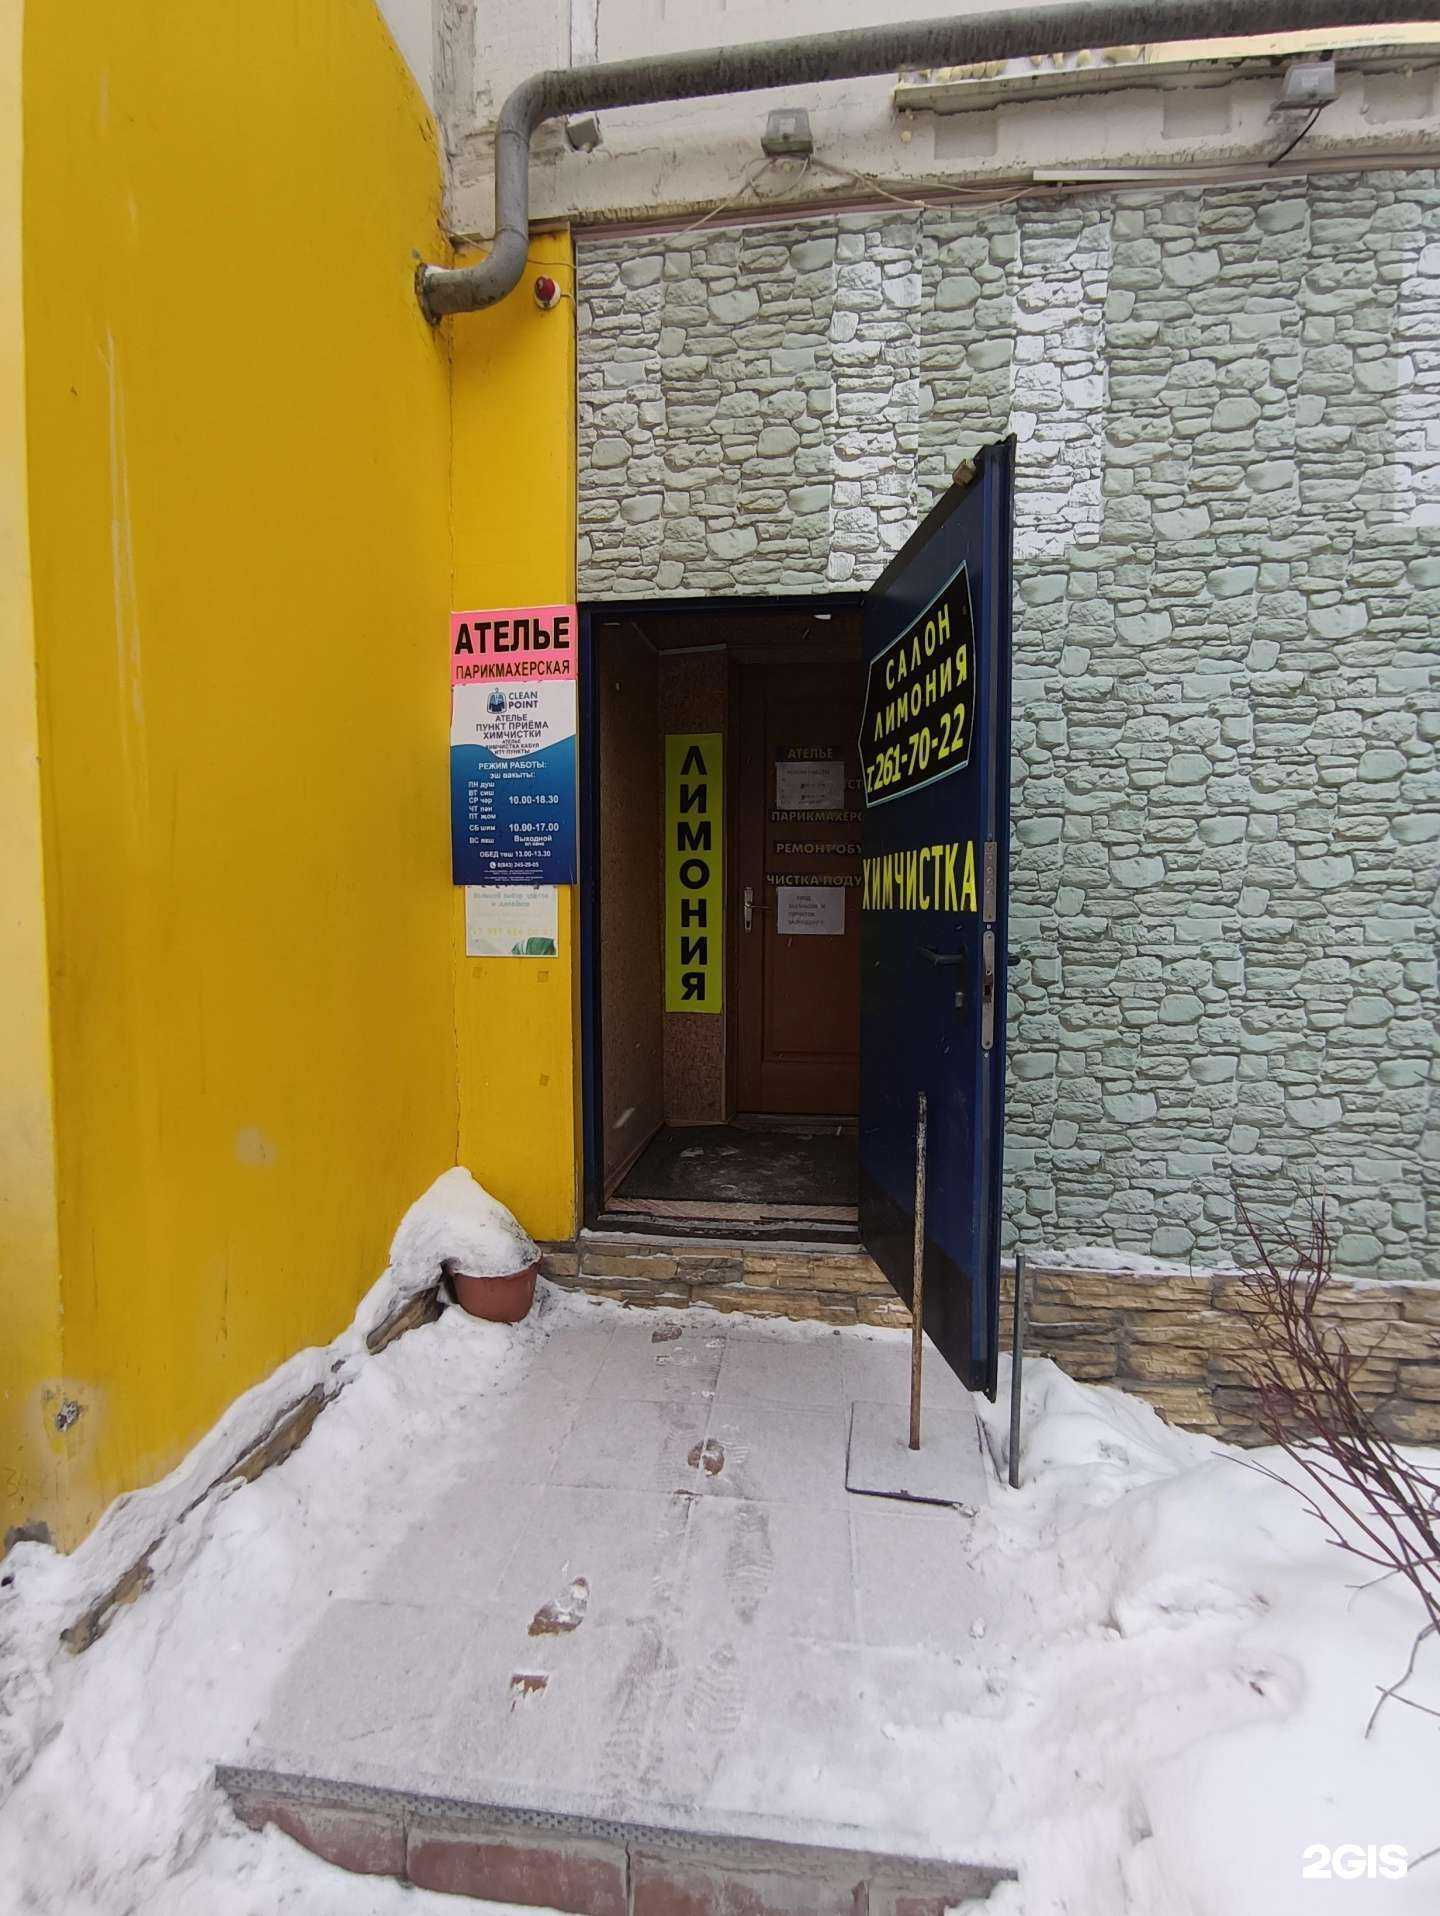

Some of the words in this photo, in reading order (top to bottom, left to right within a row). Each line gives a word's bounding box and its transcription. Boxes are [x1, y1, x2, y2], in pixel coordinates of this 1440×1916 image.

[454, 616, 570, 655] АТЕЛЬЕ
[885, 603, 951, 691] САЛОН
[455, 660, 570, 680] ПАРИКМАХЕРСКАЯ
[508, 691, 538, 700] CLEAN
[873, 643, 969, 743] ЛИМОНИЯ
[508, 700, 538, 709] POINT
[495, 713, 528, 722] АТЕЛЬЕ
[476, 722, 507, 732] ПУНКТ
[508, 719, 549, 730] ПРИЁМА
[483, 730, 541, 740] ХИМЧИСТКИ
[787, 747, 833, 760] АТЕЛЬЕ
[478, 761, 508, 771] РЕЖИМ
[468, 781, 478, 789] ПН
[509, 795, 559, 805] 10.00-18.30
[468, 812, 478, 820] ПТ
[469, 824, 479, 832] СБ
[509, 823, 560, 832] 10.00-17.00
[514, 834, 553, 843] Выходной
[776, 843, 833, 854] РЕМОНТ
[676, 745, 712, 1001] ЛИМОНИЯ
[862, 840, 979, 913] ХИМЧИСТКА
[766, 874, 821, 886] ЧИСТКА
